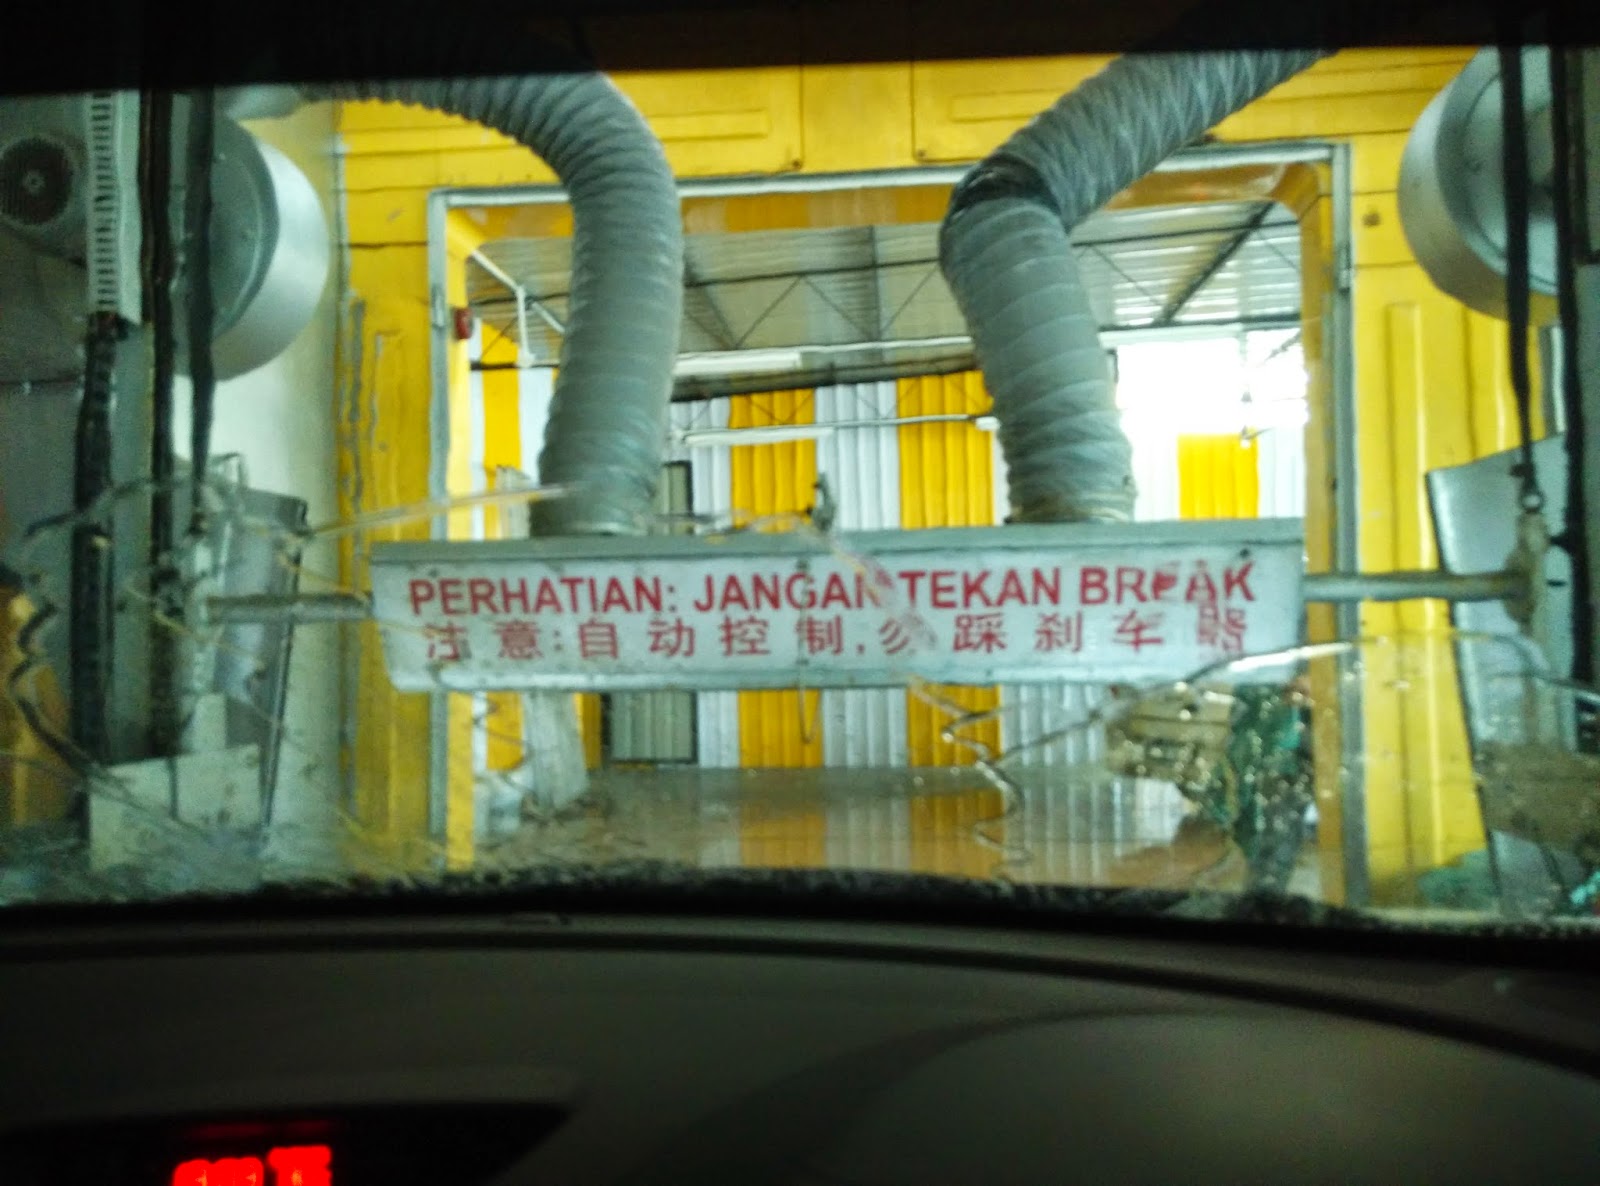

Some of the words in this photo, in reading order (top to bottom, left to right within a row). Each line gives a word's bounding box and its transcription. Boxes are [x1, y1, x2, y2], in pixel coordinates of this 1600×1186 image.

[410, 576, 677, 615] PERHATIAN:
[899, 567, 1059, 609] TEKAN
[1080, 560, 1256, 606] BREAK
